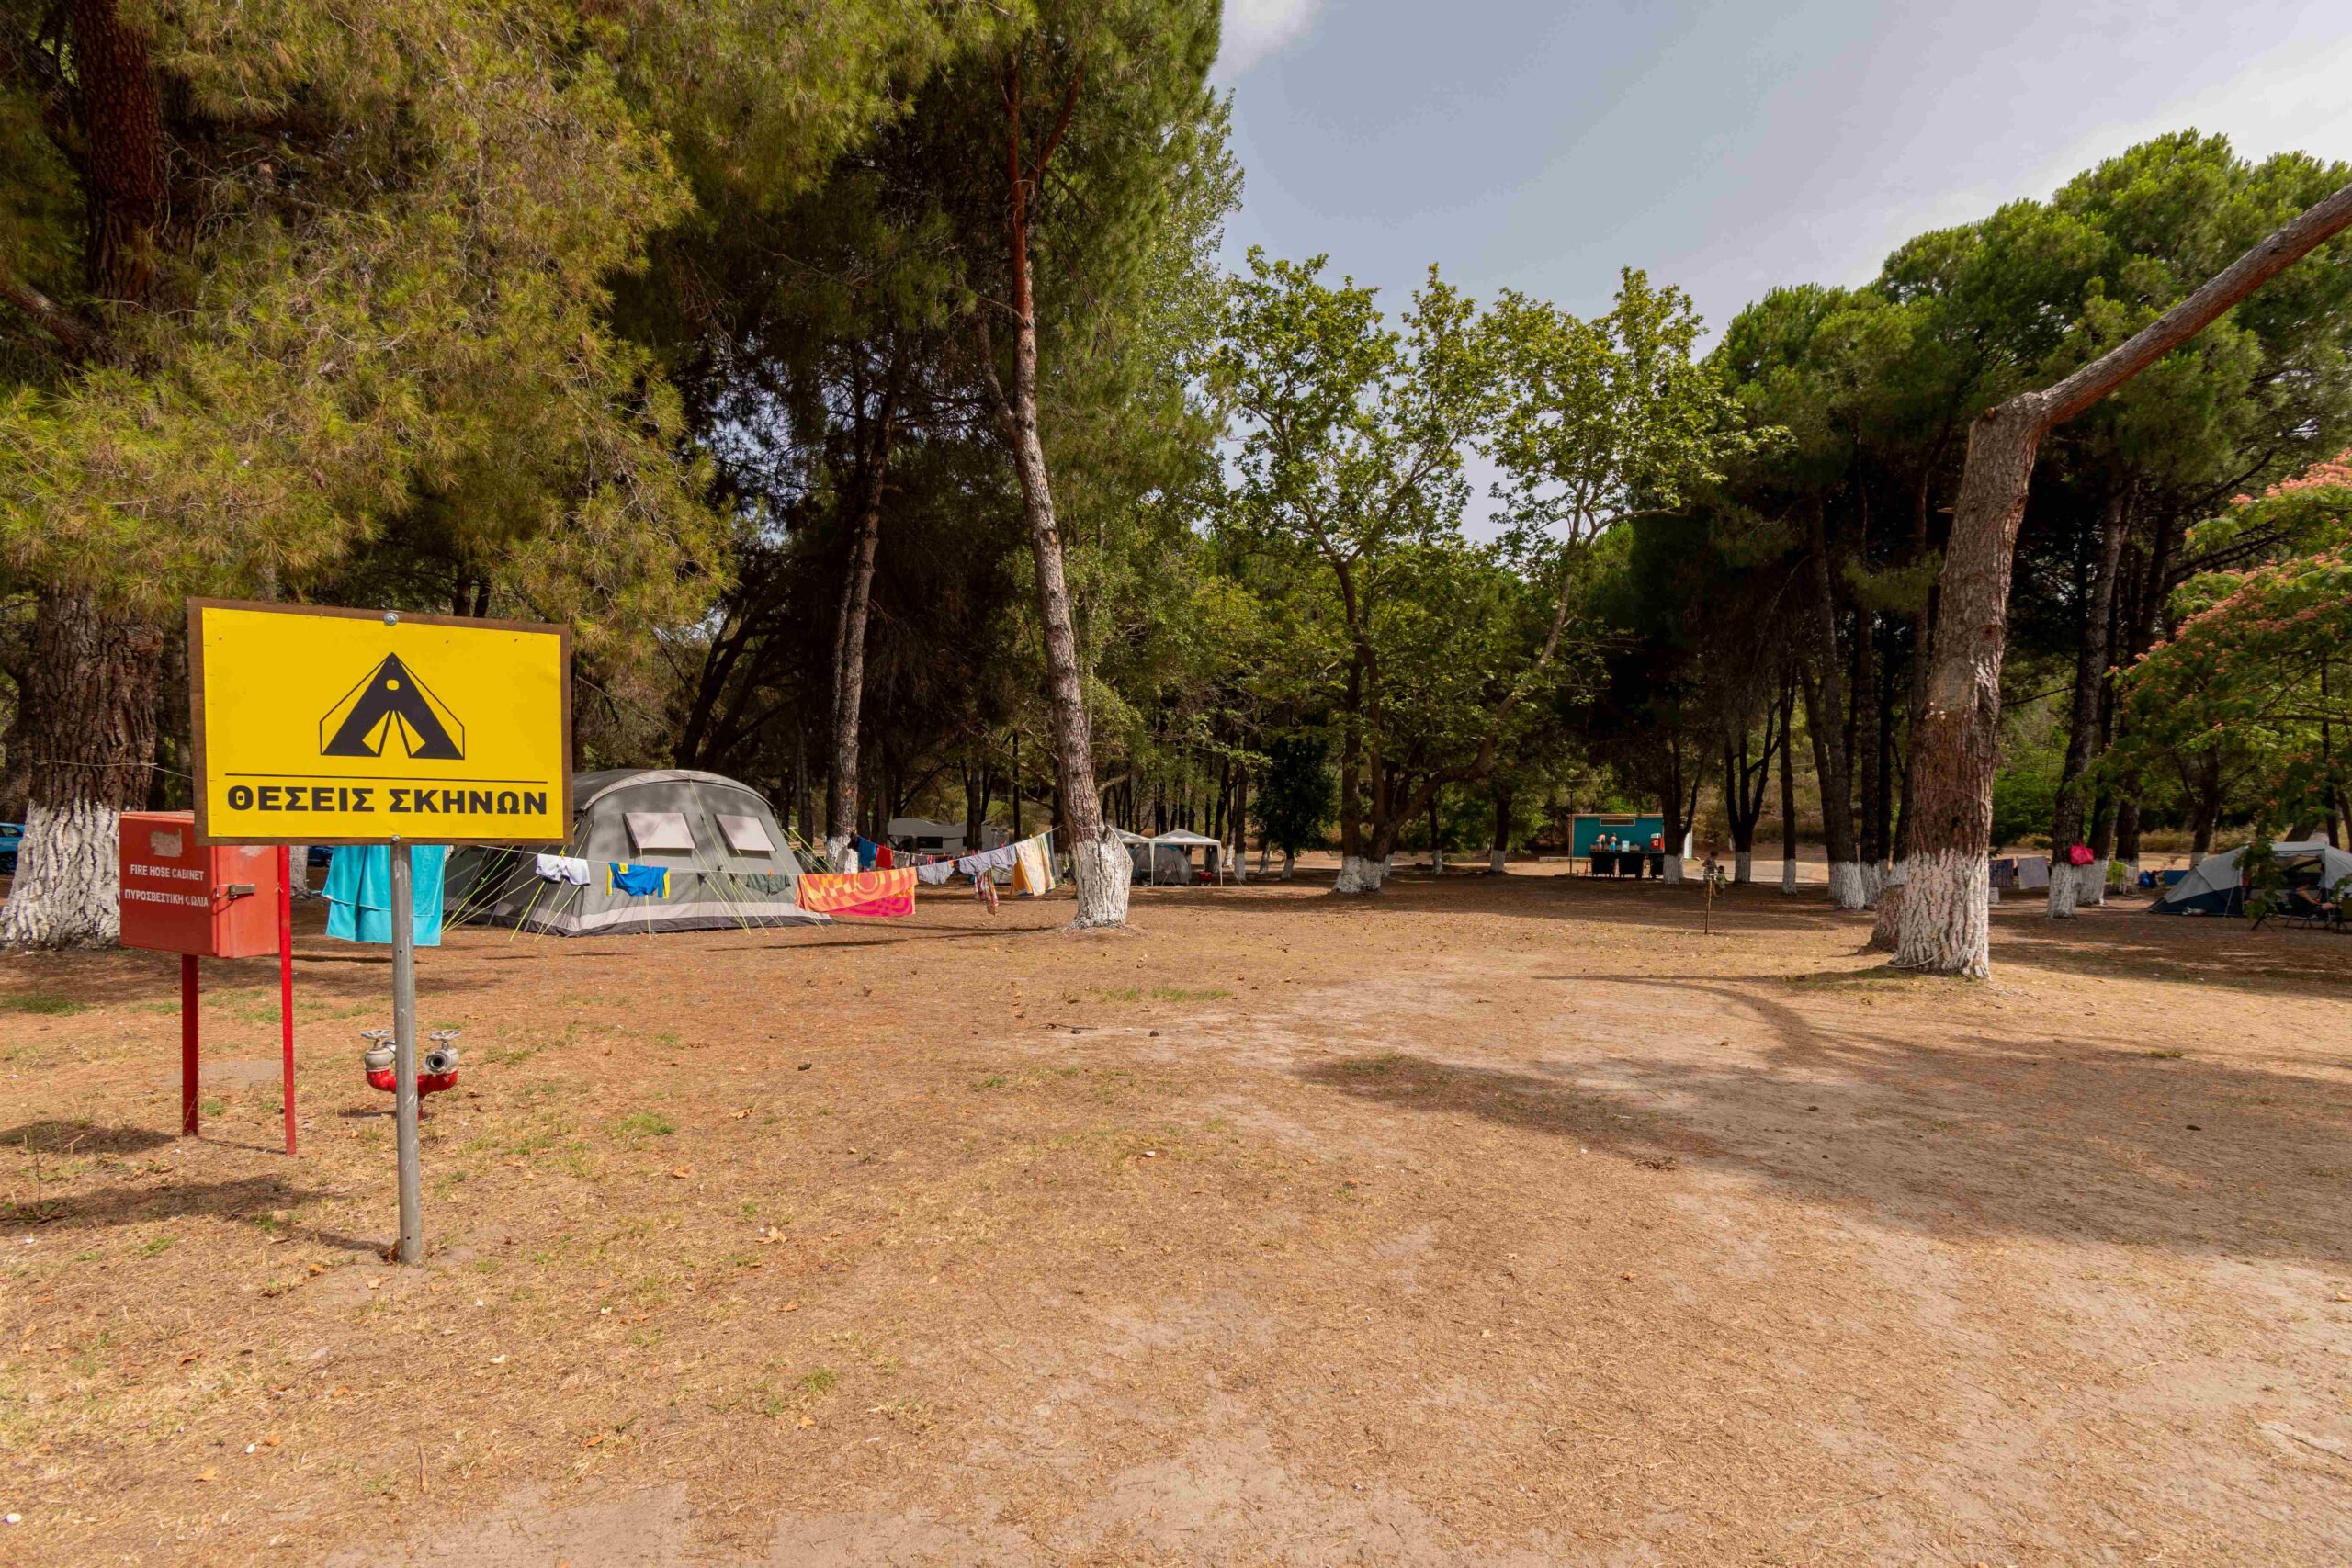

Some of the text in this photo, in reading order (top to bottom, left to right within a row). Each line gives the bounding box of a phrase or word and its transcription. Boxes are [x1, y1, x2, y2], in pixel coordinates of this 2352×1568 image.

[227, 785, 548, 815] ΘΕΣΕΙΣ ΣΚΗΝΩΝ
[130, 864, 205, 881] FIRE HOSE CABINET
[124, 888, 184, 905] ΠΥΡΟΣΒΕΣΤΙΚΗ
